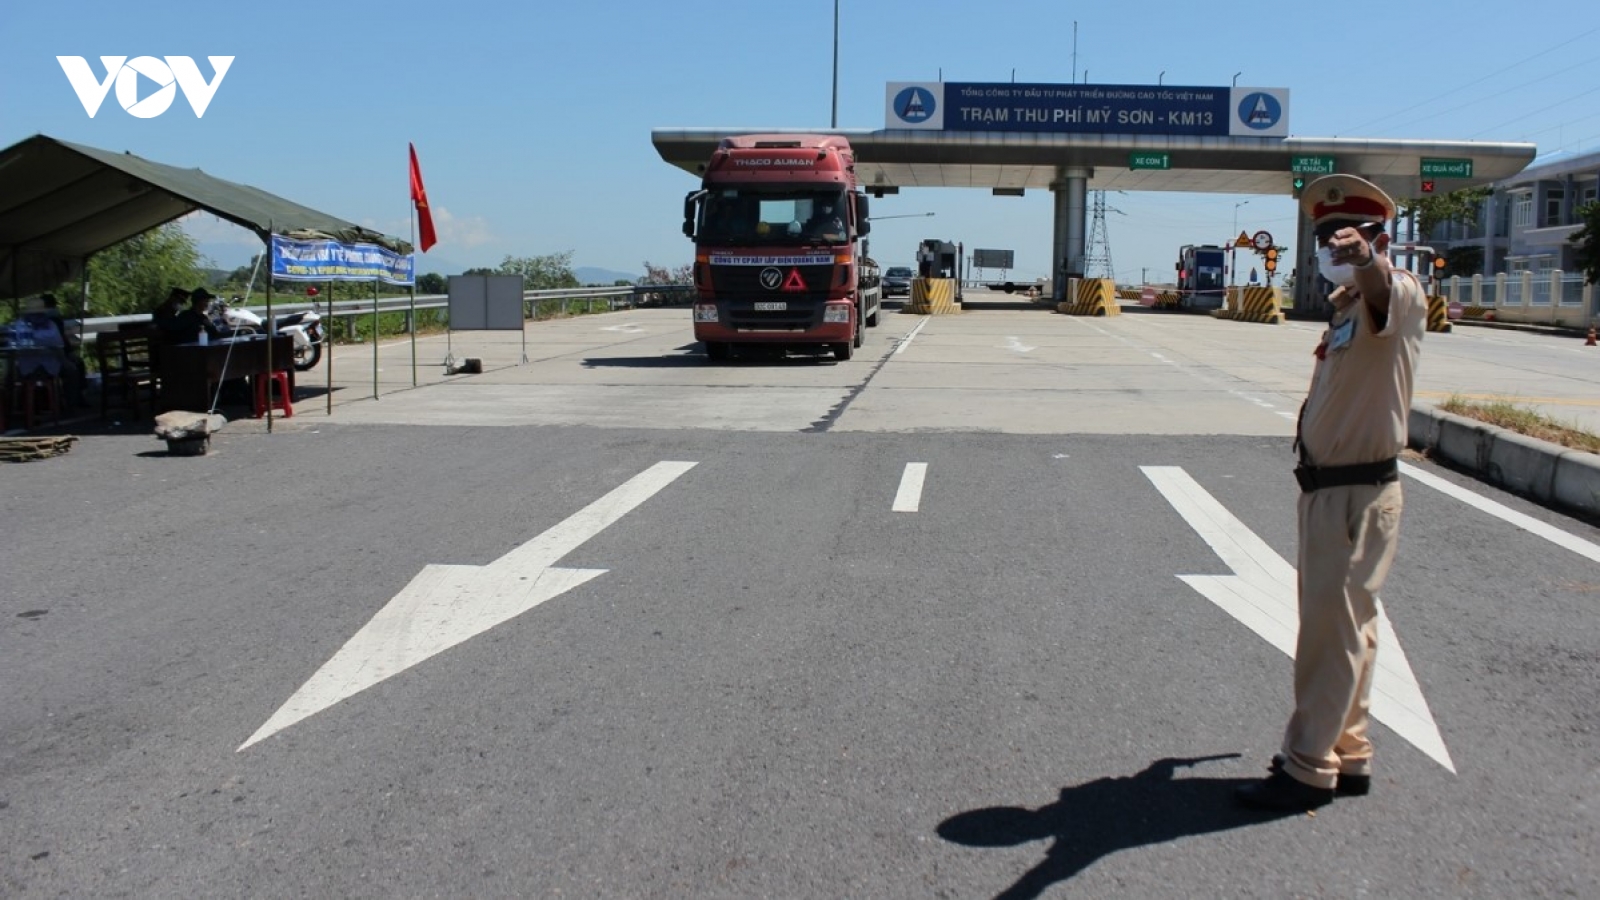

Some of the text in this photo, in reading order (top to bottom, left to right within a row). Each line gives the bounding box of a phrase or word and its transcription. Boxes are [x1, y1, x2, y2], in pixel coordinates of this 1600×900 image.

[985, 87, 1010, 97] CÔNG
[1013, 89, 1023, 97] TY
[1056, 88, 1078, 98] PHÁT
[1137, 91, 1155, 100] CAO
[1195, 93, 1214, 101] NAM
[960, 107, 1009, 124] TRẠM
[1014, 108, 1049, 122] THU
[1053, 105, 1083, 123] PHÍ
[1086, 105, 1112, 123] MỸ
[1117, 108, 1154, 124] SƠN
[1168, 110, 1214, 126] KM13
[734, 158, 815, 166] THACO AUMAN
[1135, 157, 1145, 165] XE
